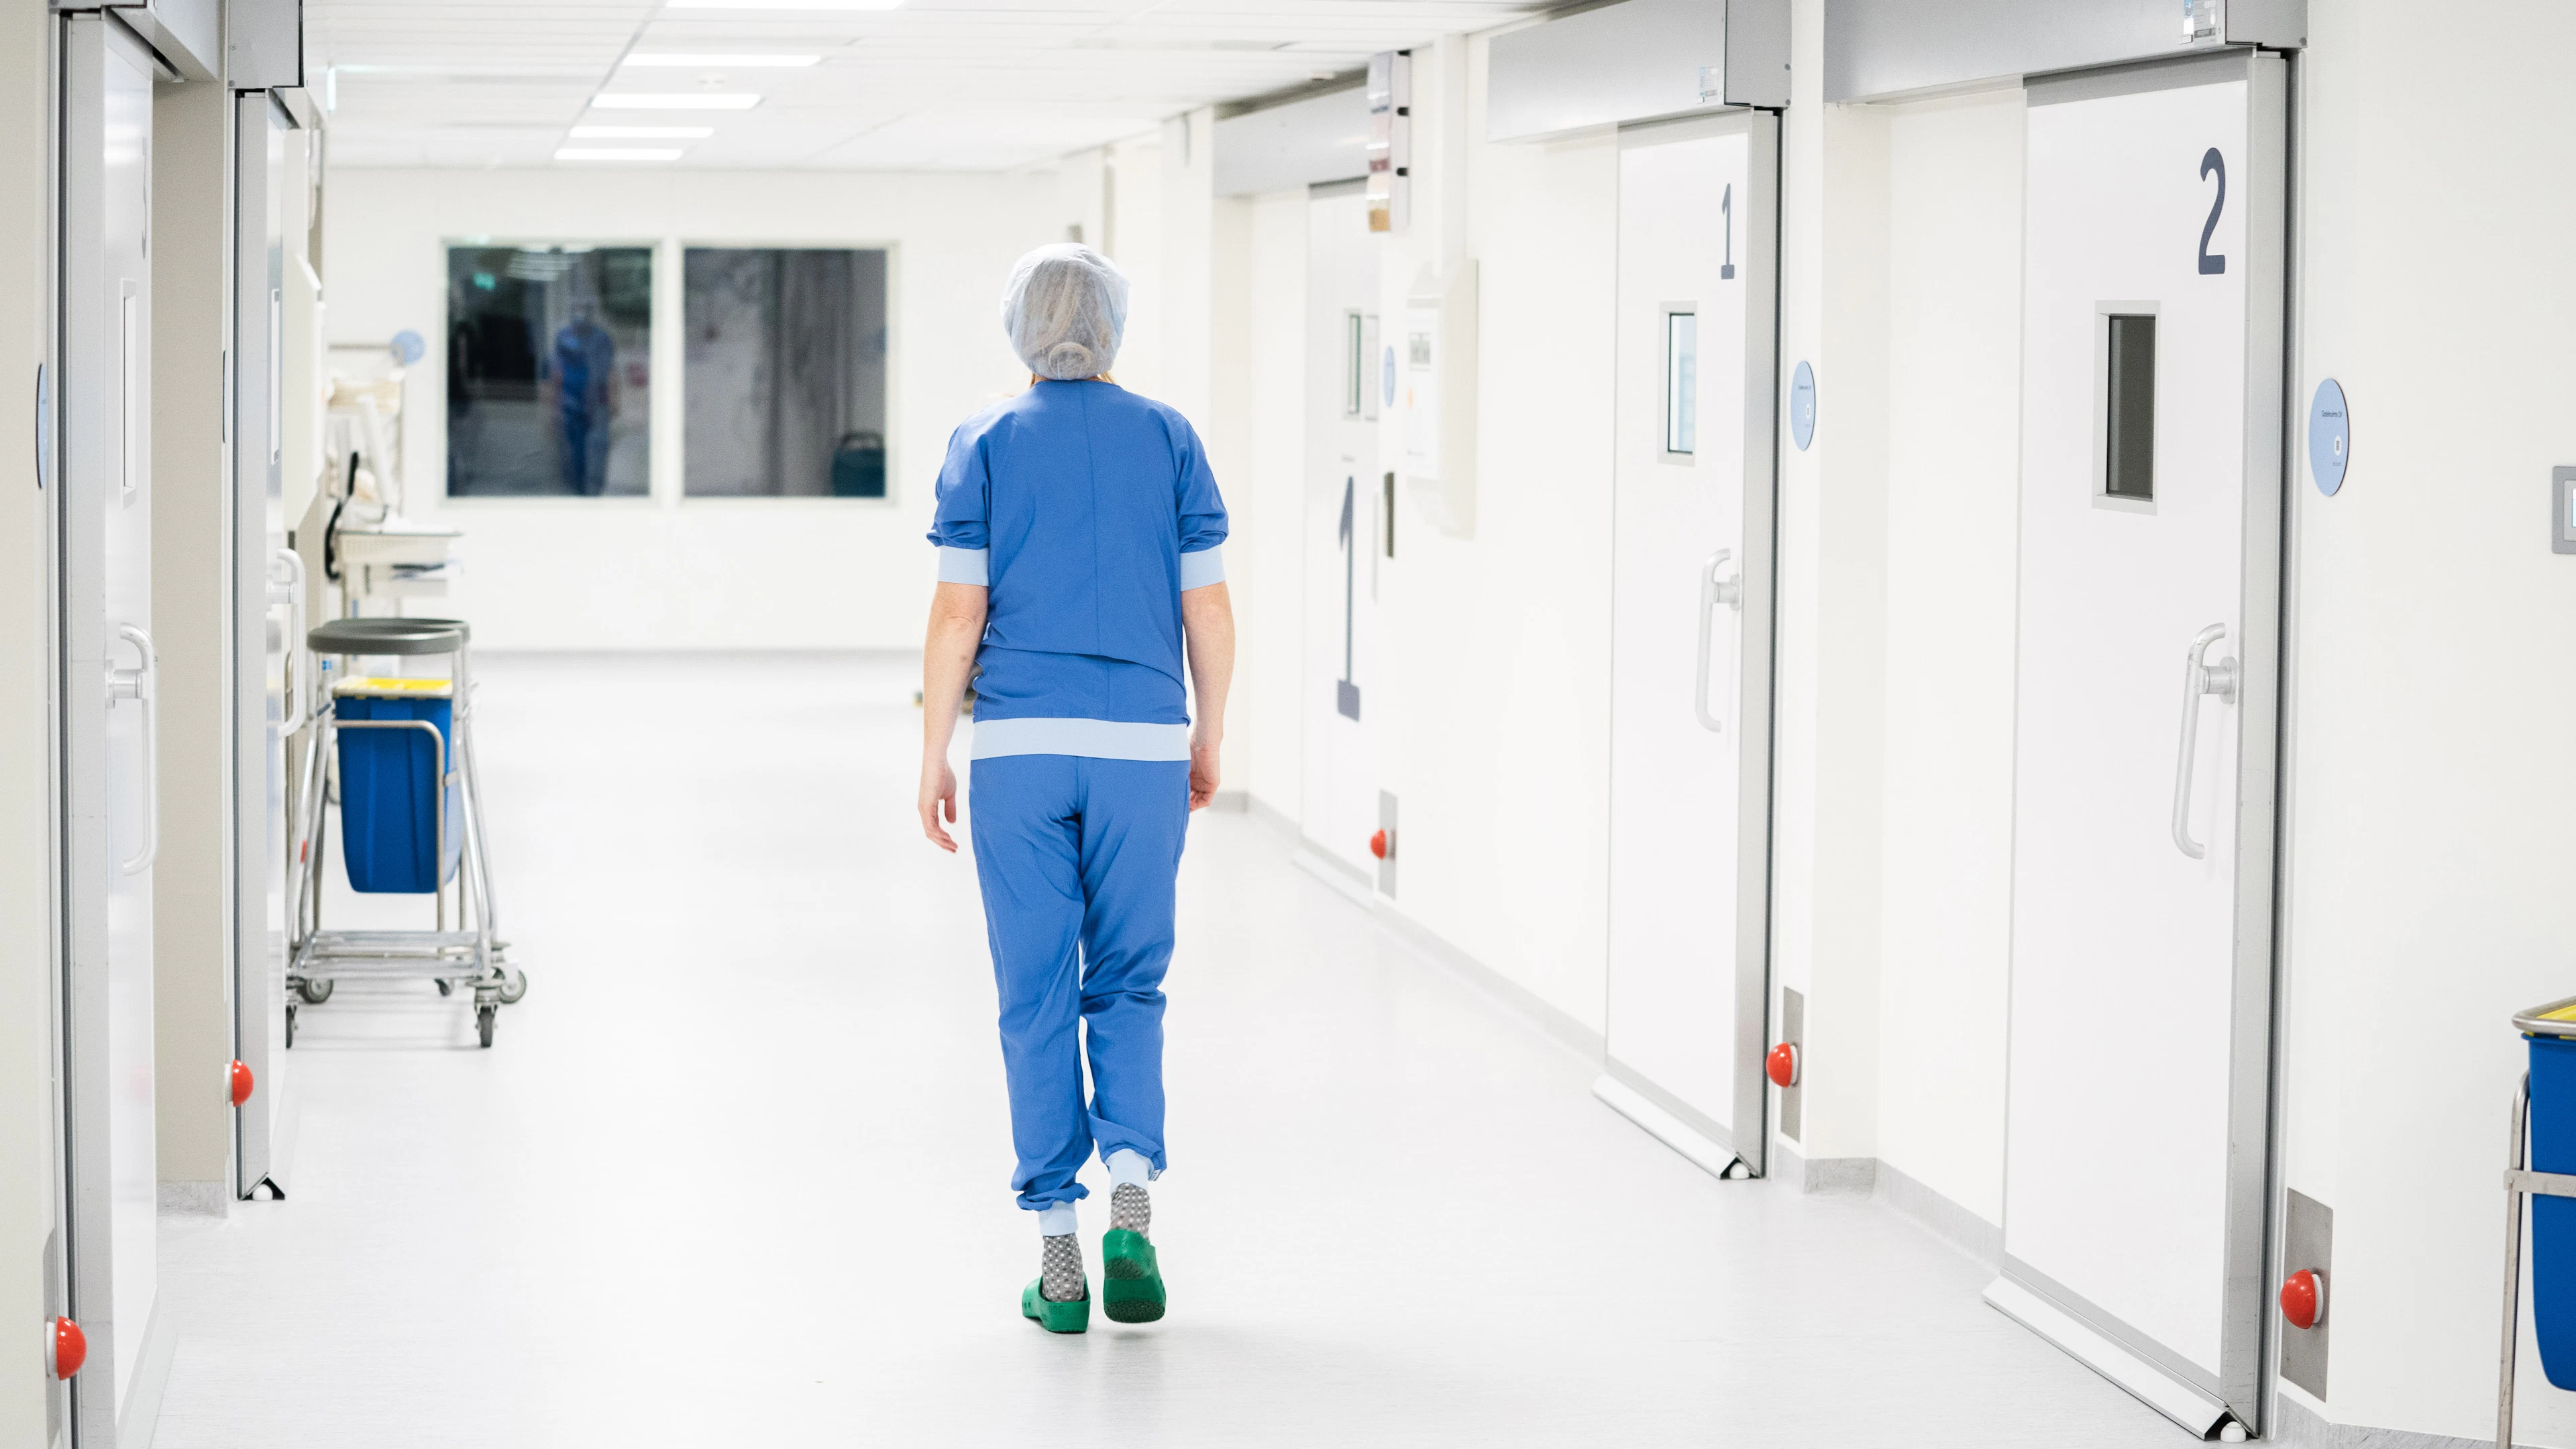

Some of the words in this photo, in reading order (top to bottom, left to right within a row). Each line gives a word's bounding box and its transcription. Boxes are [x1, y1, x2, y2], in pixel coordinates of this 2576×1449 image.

[1721, 182, 1735, 280] 1
[2198, 147, 2226, 275] 2
[1336, 476, 1360, 722] 1
